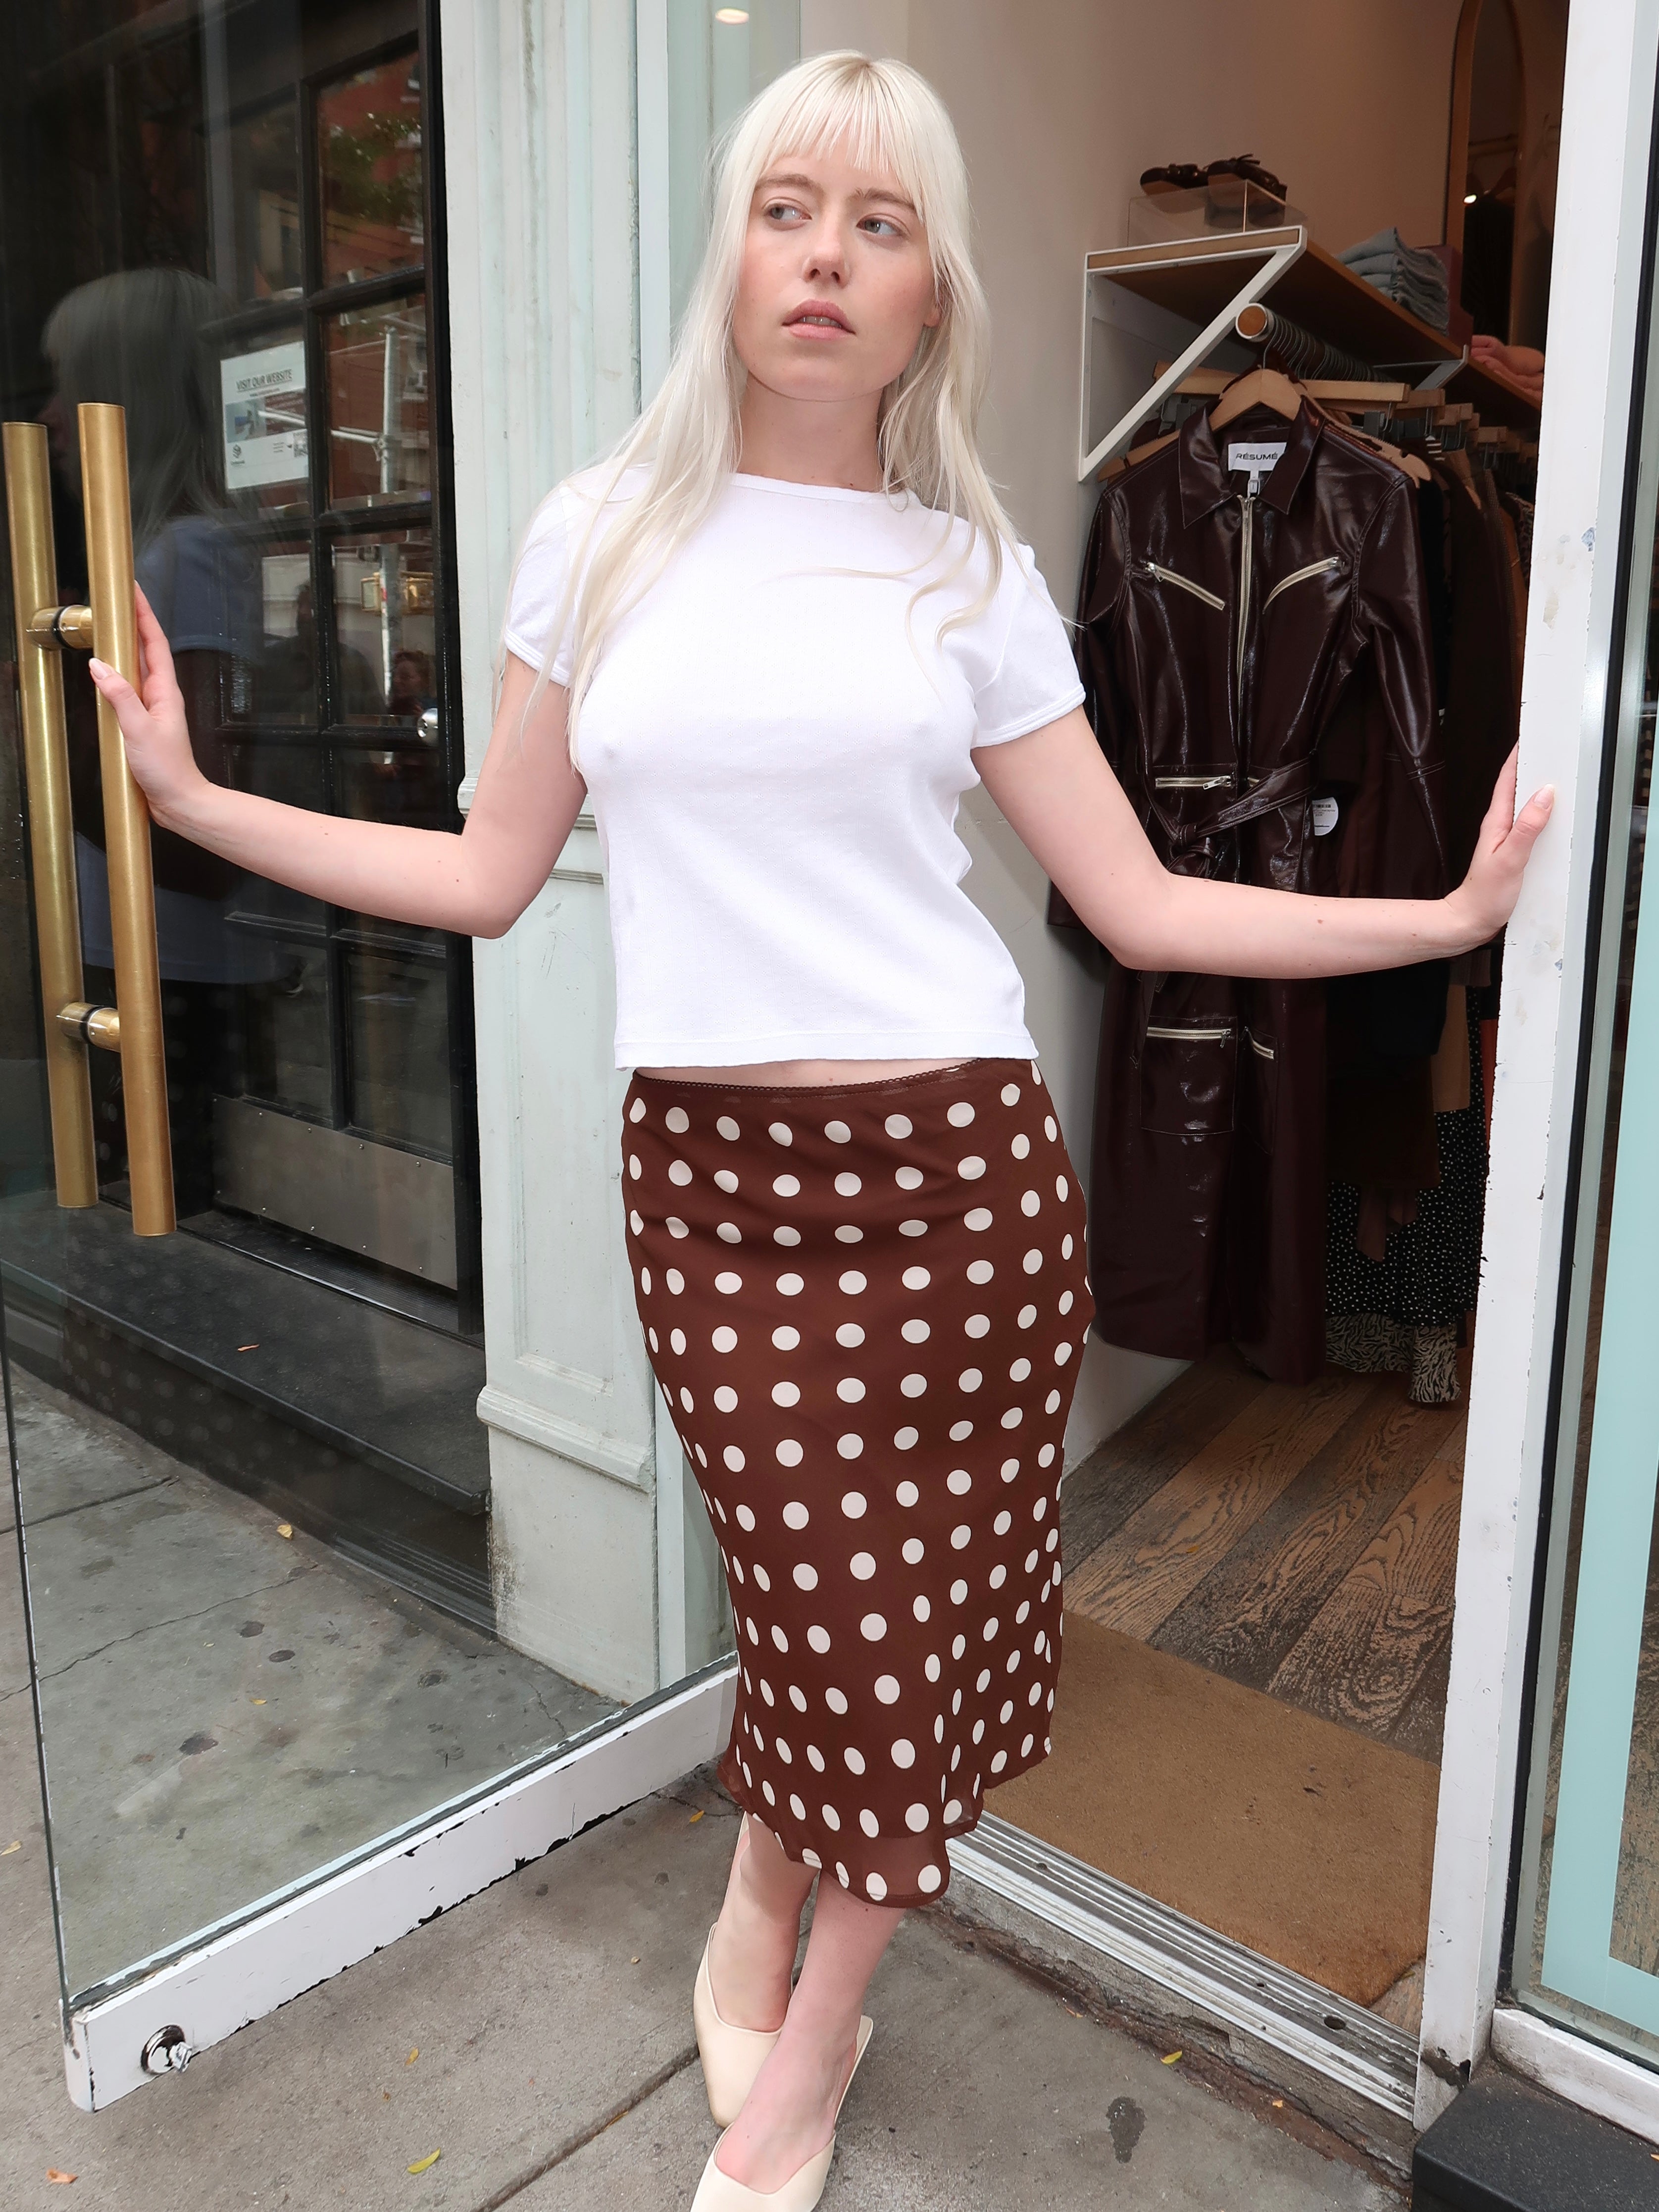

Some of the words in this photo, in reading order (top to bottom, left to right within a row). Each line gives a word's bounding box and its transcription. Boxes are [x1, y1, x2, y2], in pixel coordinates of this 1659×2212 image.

[236, 377, 251, 390] VISIT
[252, 375, 265, 387] OUR
[266, 368, 293, 384] WEBSITE
[1236, 452, 1278, 460] RÉSUMÉ
